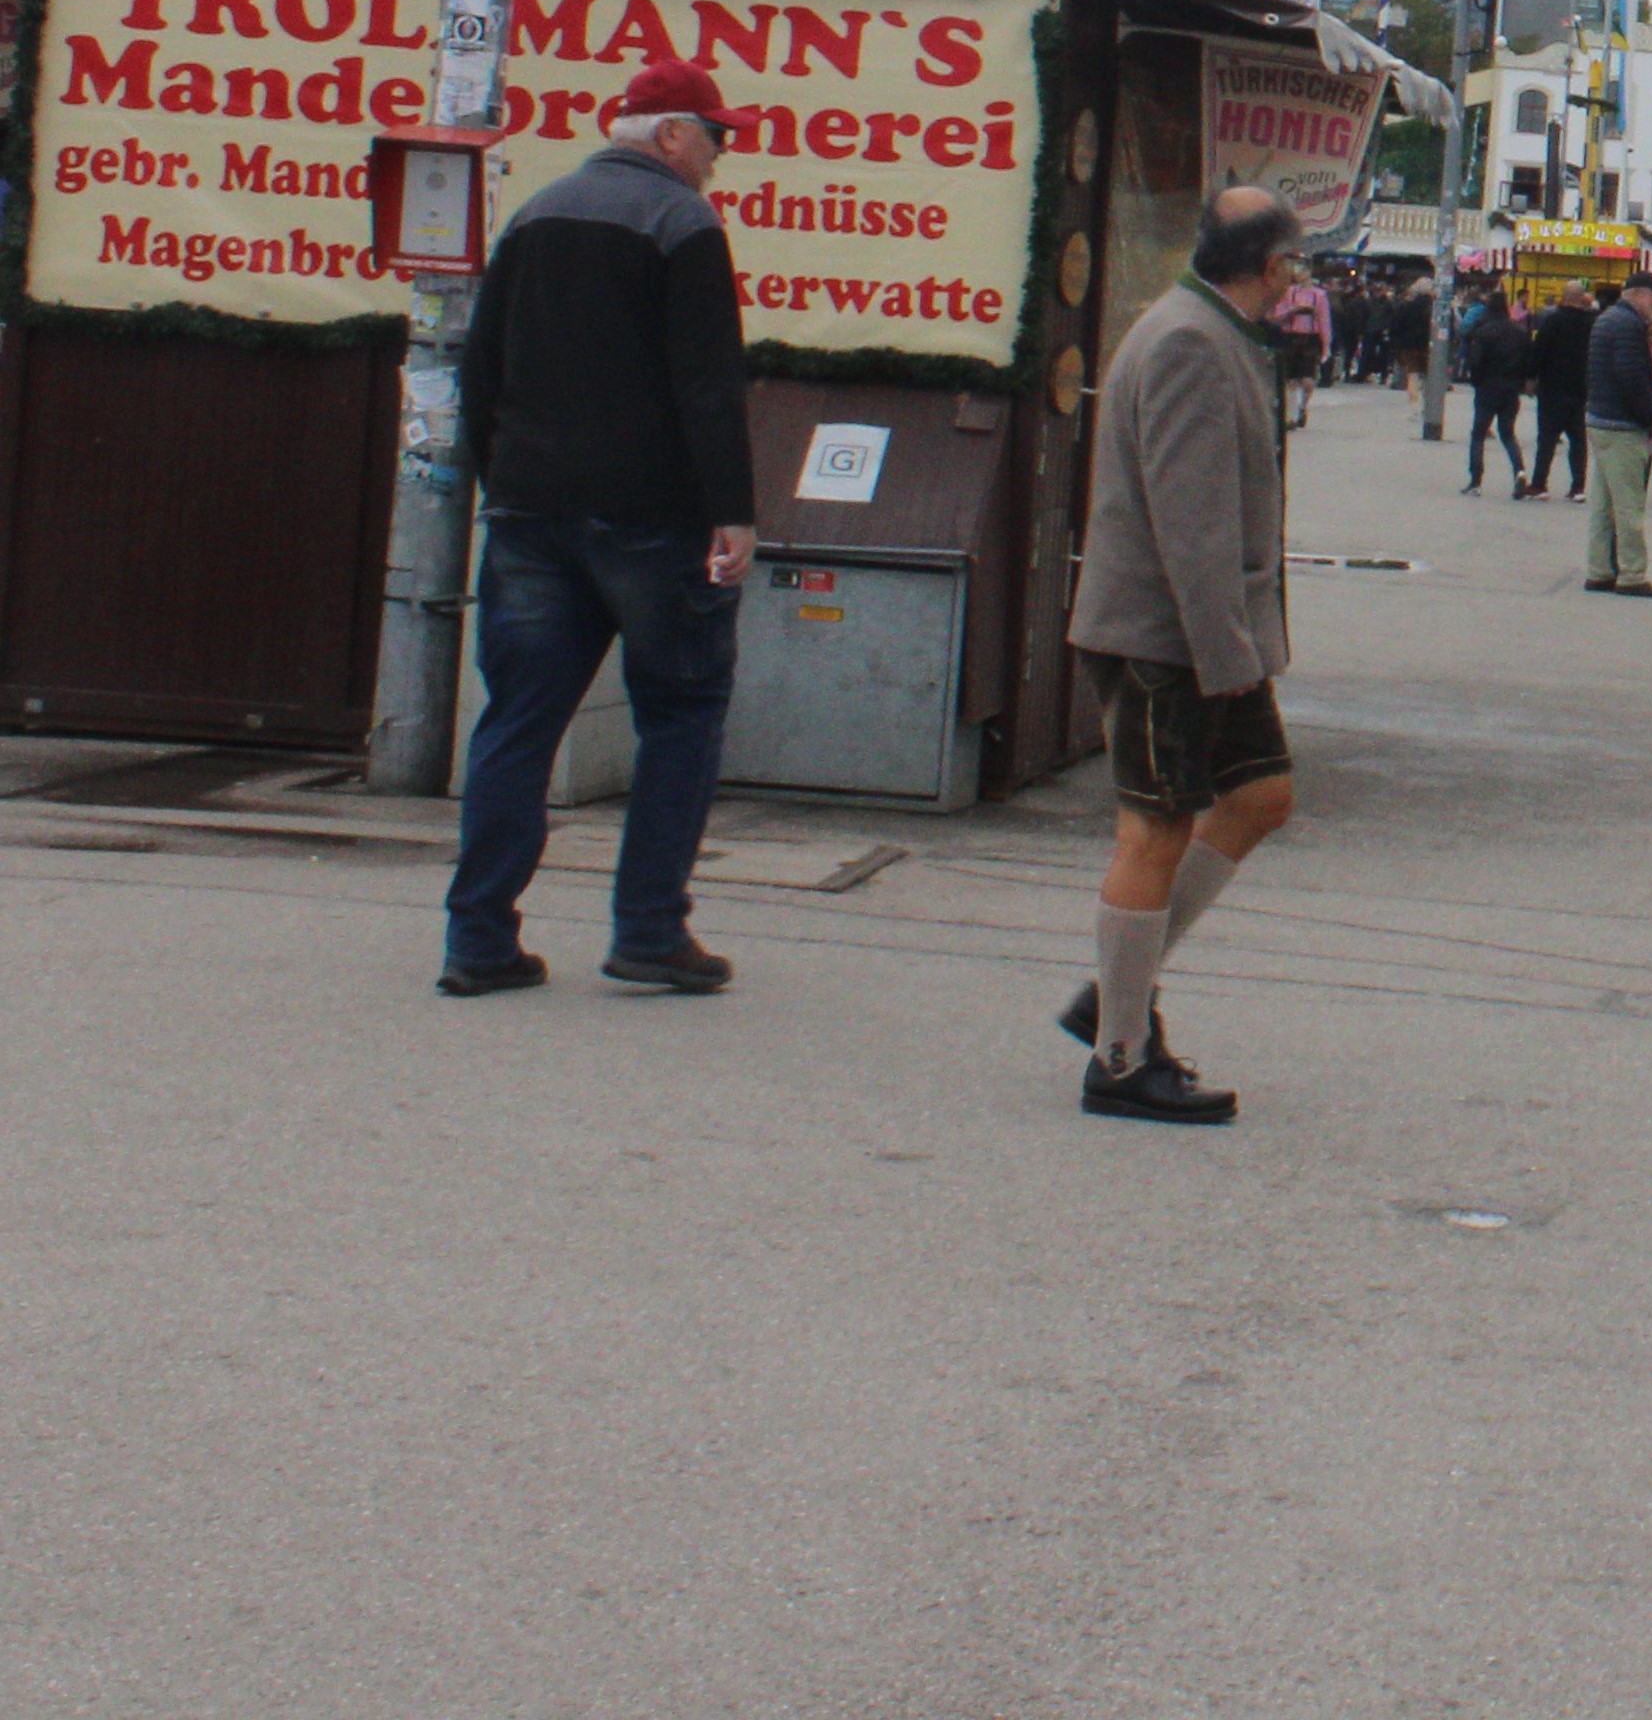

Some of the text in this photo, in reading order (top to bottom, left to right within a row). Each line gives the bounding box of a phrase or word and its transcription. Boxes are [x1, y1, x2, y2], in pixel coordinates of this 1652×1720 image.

[60, 34, 1016, 171] Mandernerei
[1216, 59, 1371, 116] TÜRKISCHER
[1216, 99, 1353, 159] HONIG
[54, 136, 373, 200] gebr. Mand
[707, 180, 948, 240] rdnüsse
[830, 449, 856, 472] G
